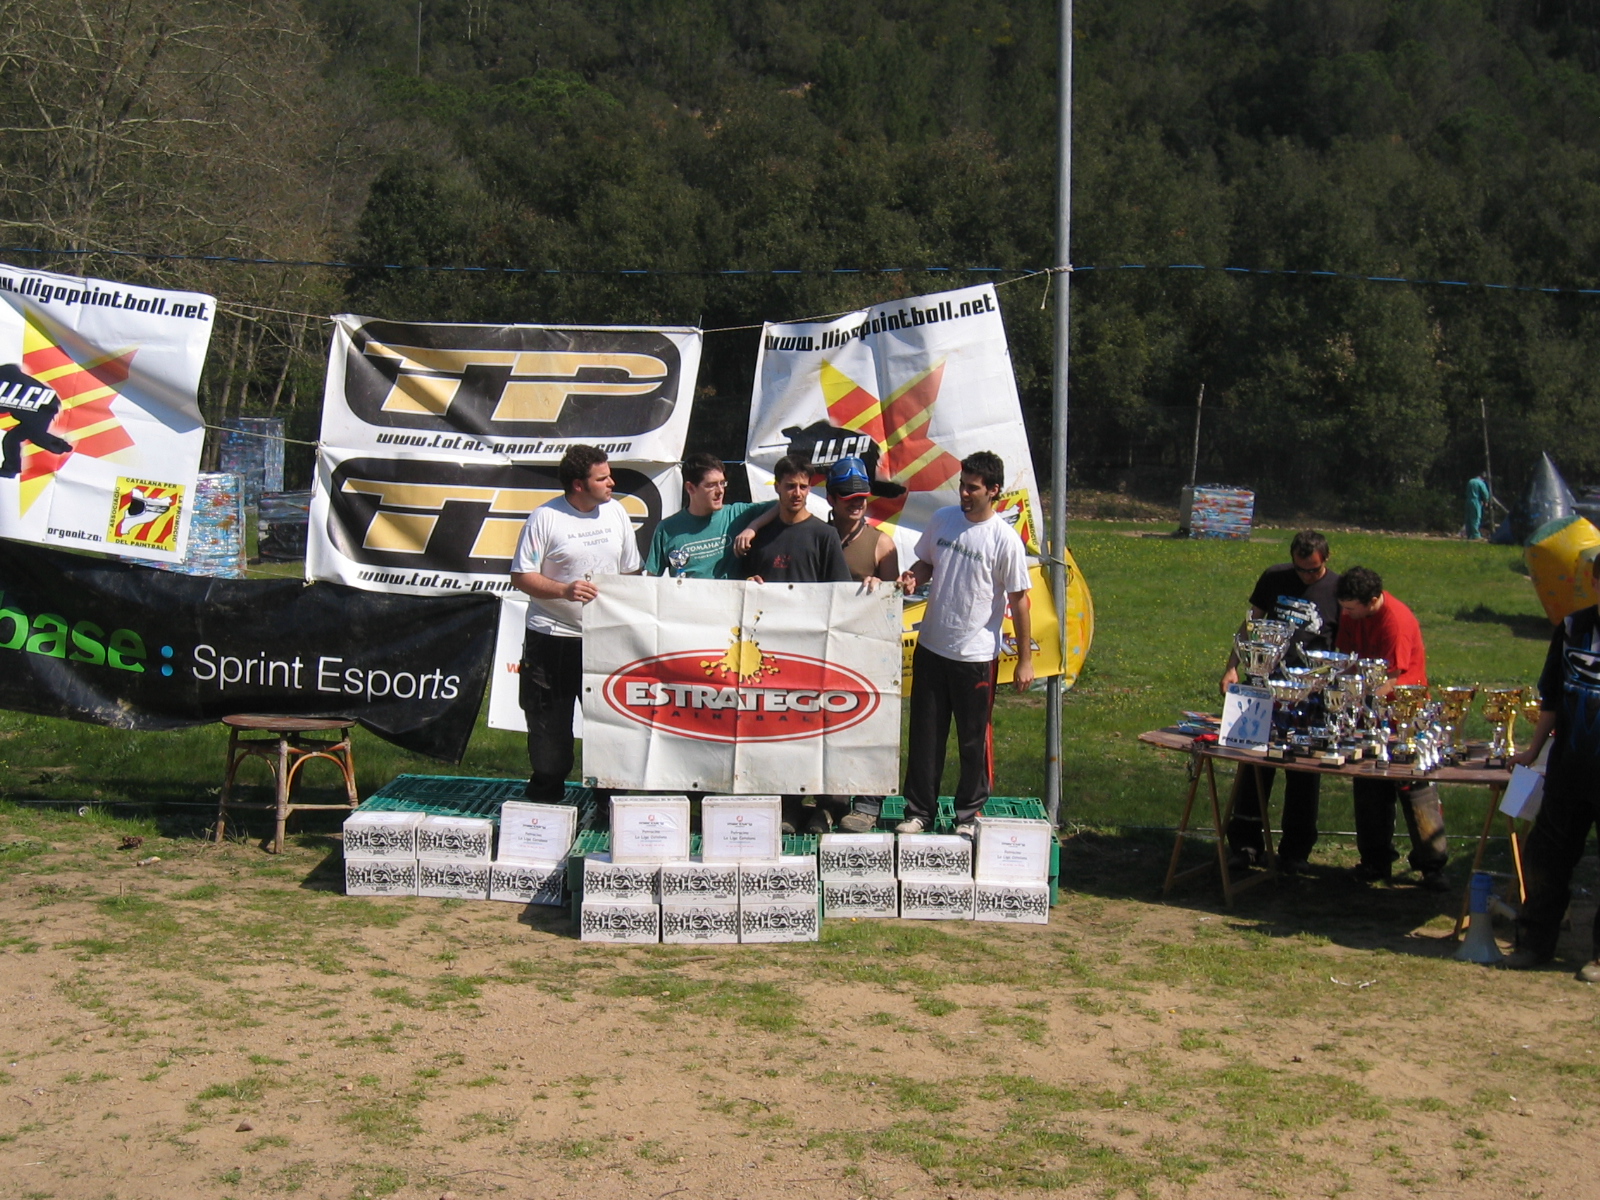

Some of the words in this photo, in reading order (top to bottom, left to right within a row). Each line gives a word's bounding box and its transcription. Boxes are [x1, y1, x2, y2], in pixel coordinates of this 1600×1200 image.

[811, 435, 871, 465] LLCP
[125, 477, 162, 487] CATALANA
[130, 541, 168, 551] PAINTBALL
[192, 644, 304, 691] Sprint
[317, 656, 461, 703] Esports
[625, 681, 859, 713] ESTRATEGO
[651, 709, 831, 723] PAINTBALL
